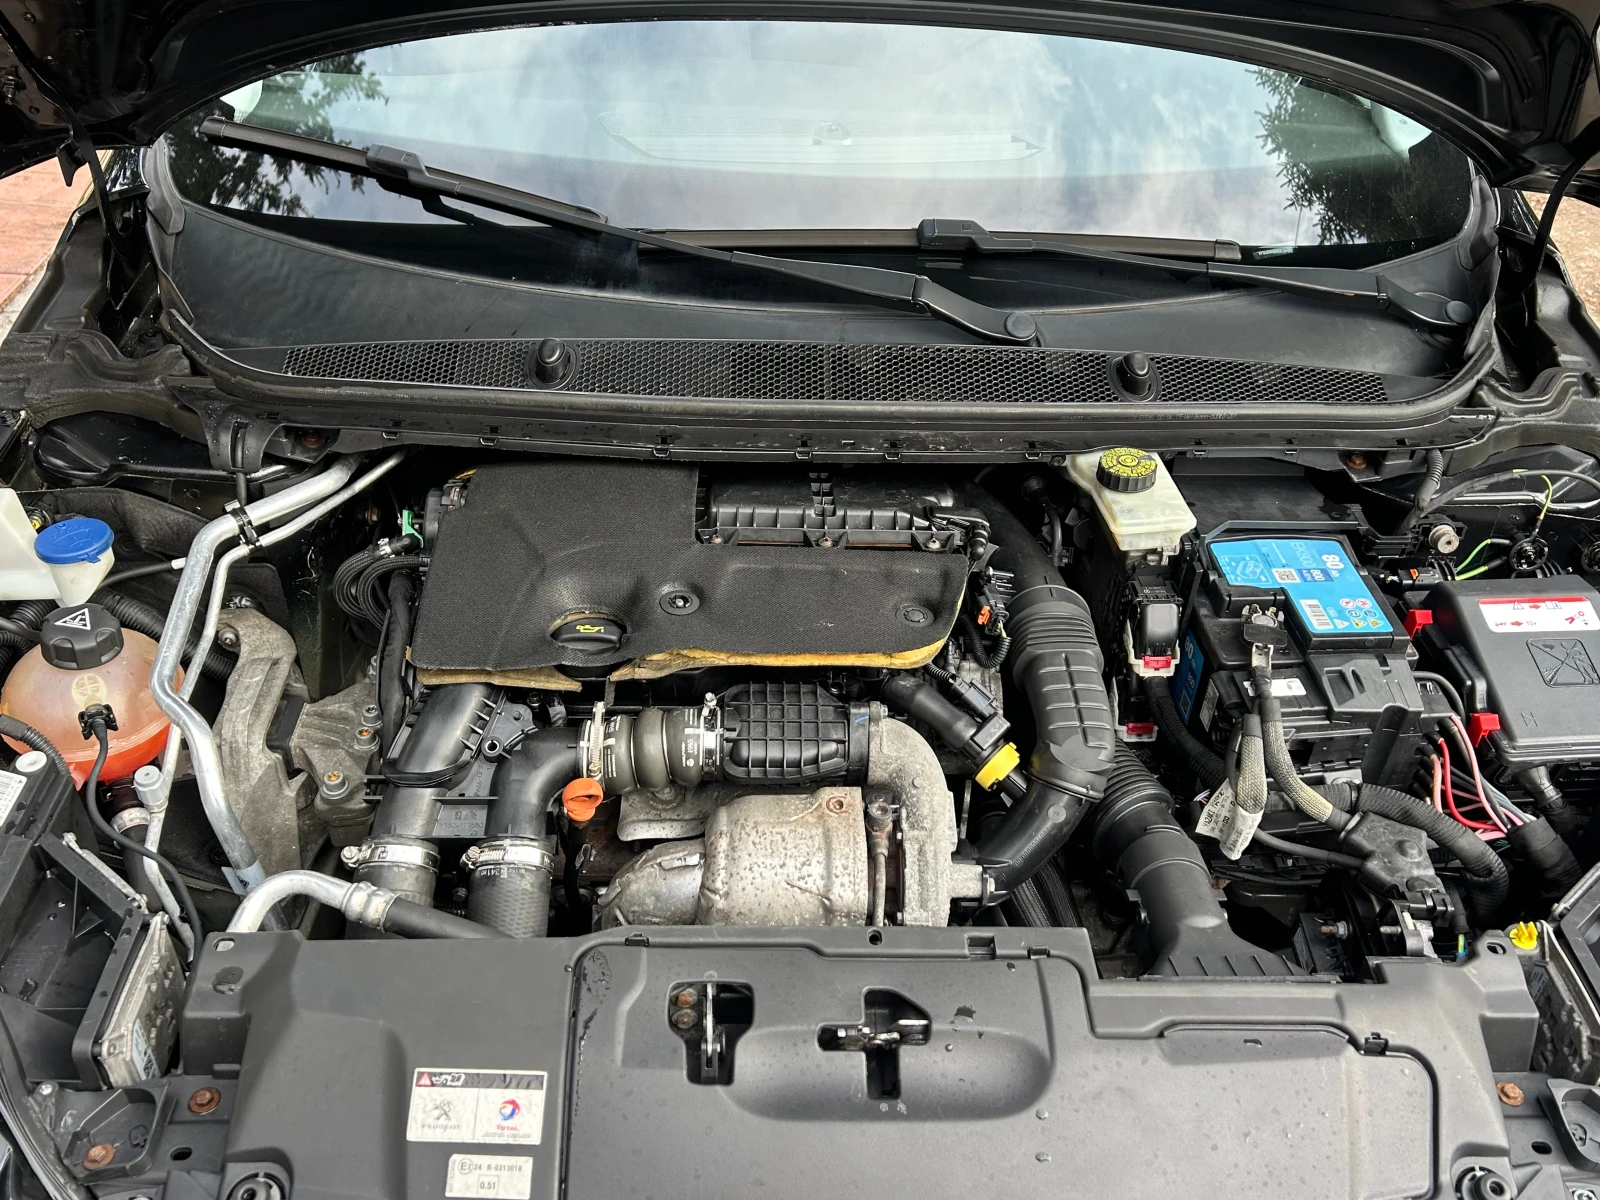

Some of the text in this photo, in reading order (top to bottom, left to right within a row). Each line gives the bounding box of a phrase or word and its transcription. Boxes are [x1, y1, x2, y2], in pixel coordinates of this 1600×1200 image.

[1321, 554, 1345, 570] 80
[1184, 635, 1194, 660] 80
[421, 1123, 461, 1132] PEUGEOT
[479, 1181, 497, 1190] 0.51
